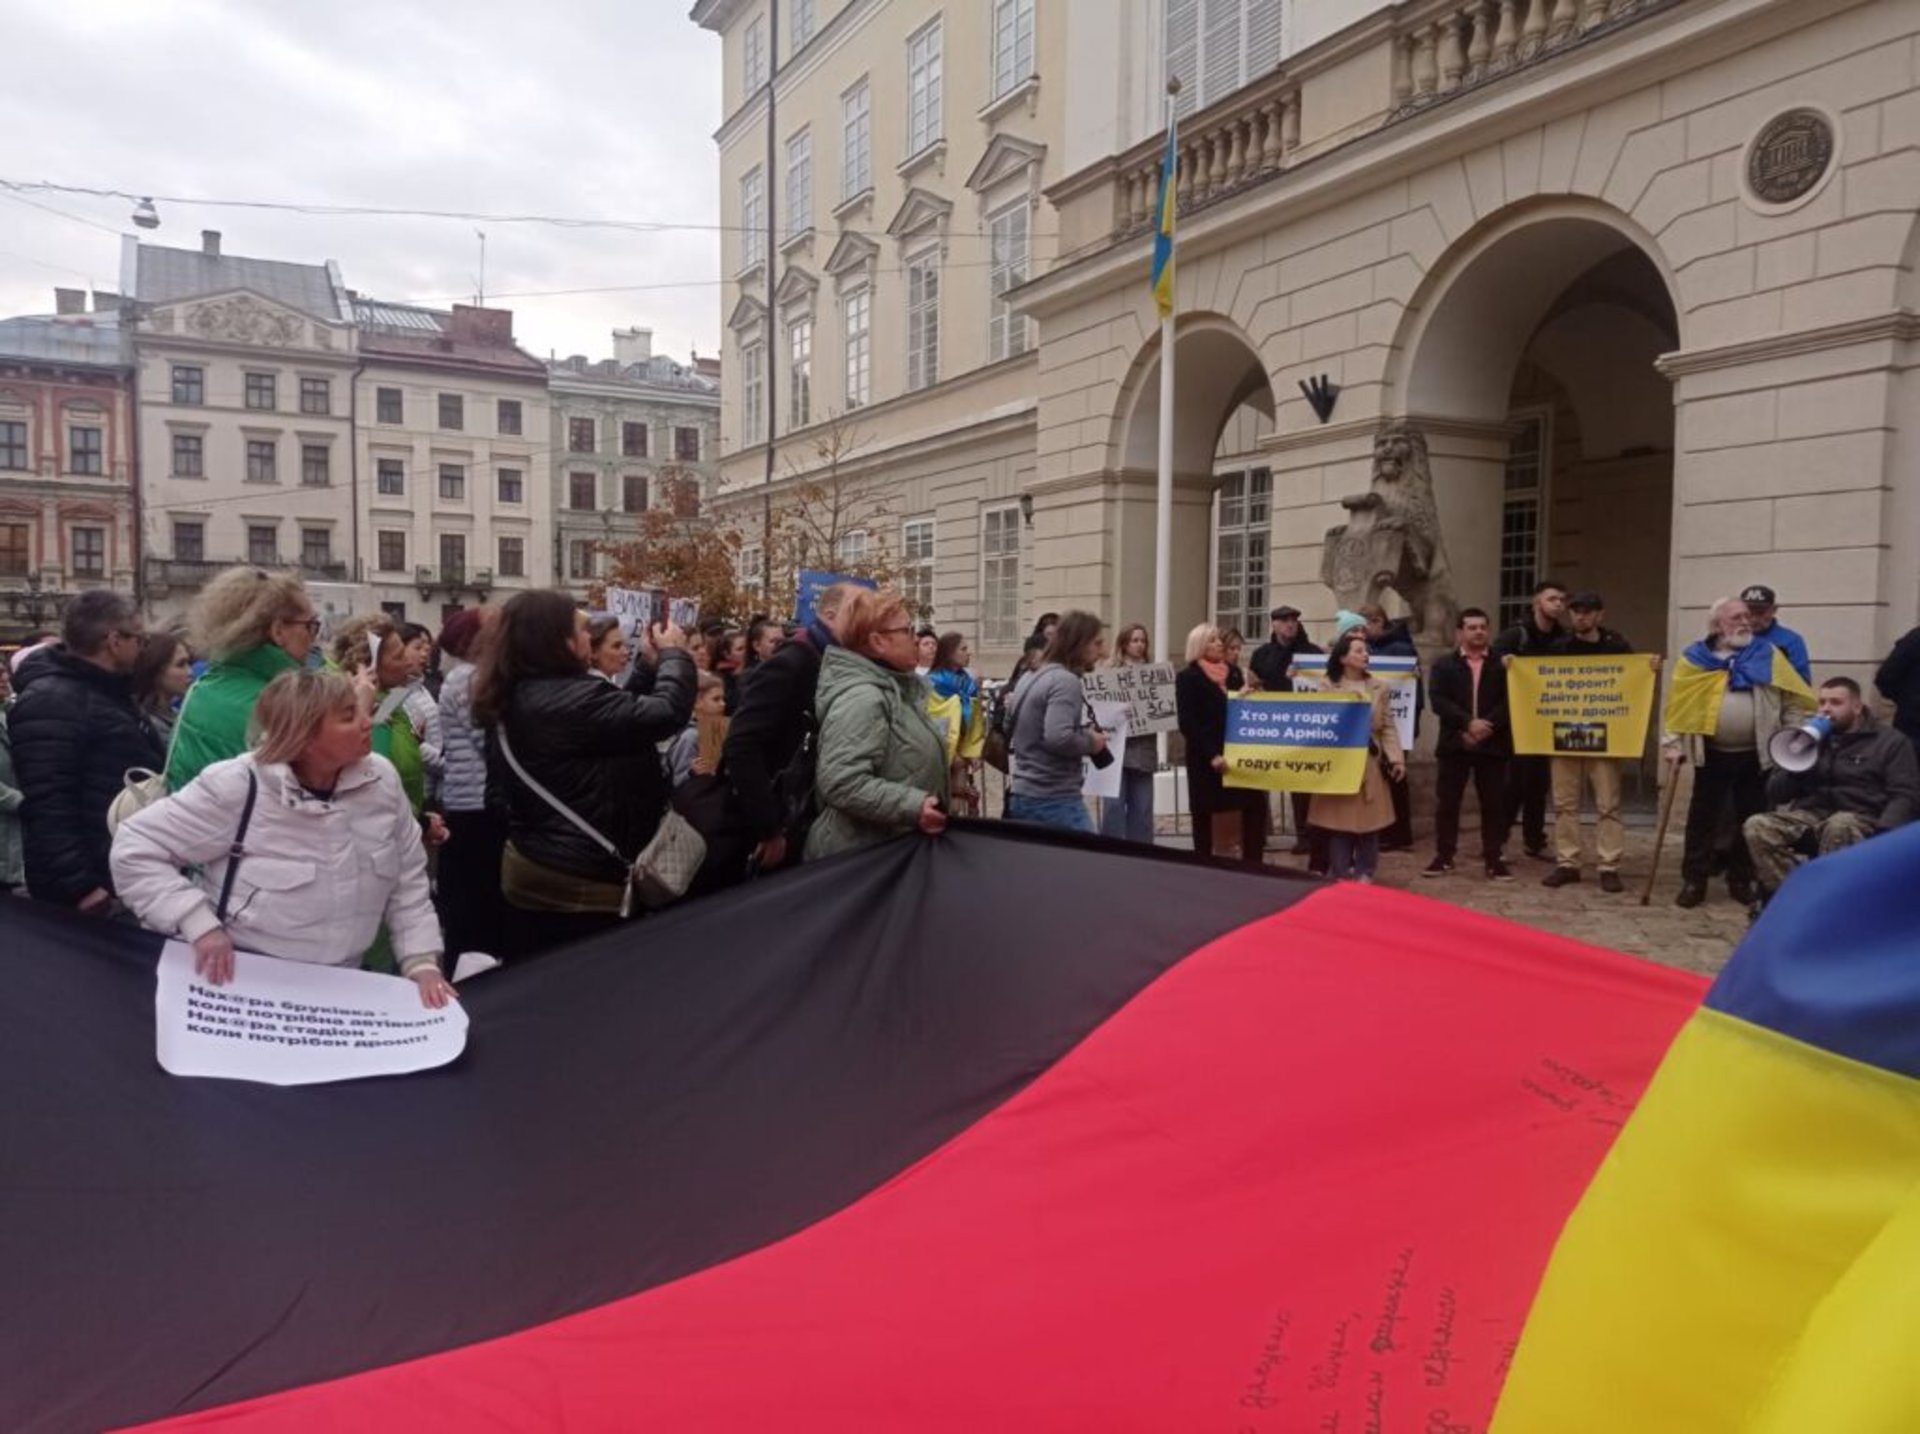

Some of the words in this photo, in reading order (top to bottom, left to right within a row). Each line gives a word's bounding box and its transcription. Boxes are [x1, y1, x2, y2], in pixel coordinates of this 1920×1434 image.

[1558, 665, 1575, 675] не
[1578, 664, 1625, 675] хочете
[1084, 674, 1107, 691] ЦЕ
[1117, 670, 1137, 689] НЕ
[1565, 678, 1616, 690] фронт?
[1137, 688, 1159, 701] ЦЕ
[1540, 692, 1580, 703] Дайте
[1583, 691, 1623, 703] гроші
[1240, 709, 1268, 722] Хто
[1272, 713, 1290, 723] не
[1294, 713, 1340, 727] годує
[1239, 726, 1280, 737] свою
[1283, 726, 1339, 742] Армію,
[1236, 757, 1282, 771] годує
[1285, 760, 1332, 774] чужу!
[188, 983, 277, 1009] Нах@ра
[281, 999, 376, 1019] бруківка
[187, 998, 243, 1015] коли
[246, 1005, 345, 1027] потрібна
[187, 1009, 278, 1032] Нах@ра
[283, 1023, 366, 1038] стадіон
[186, 1022, 243, 1040] коли
[247, 1030, 349, 1049] потрібен
